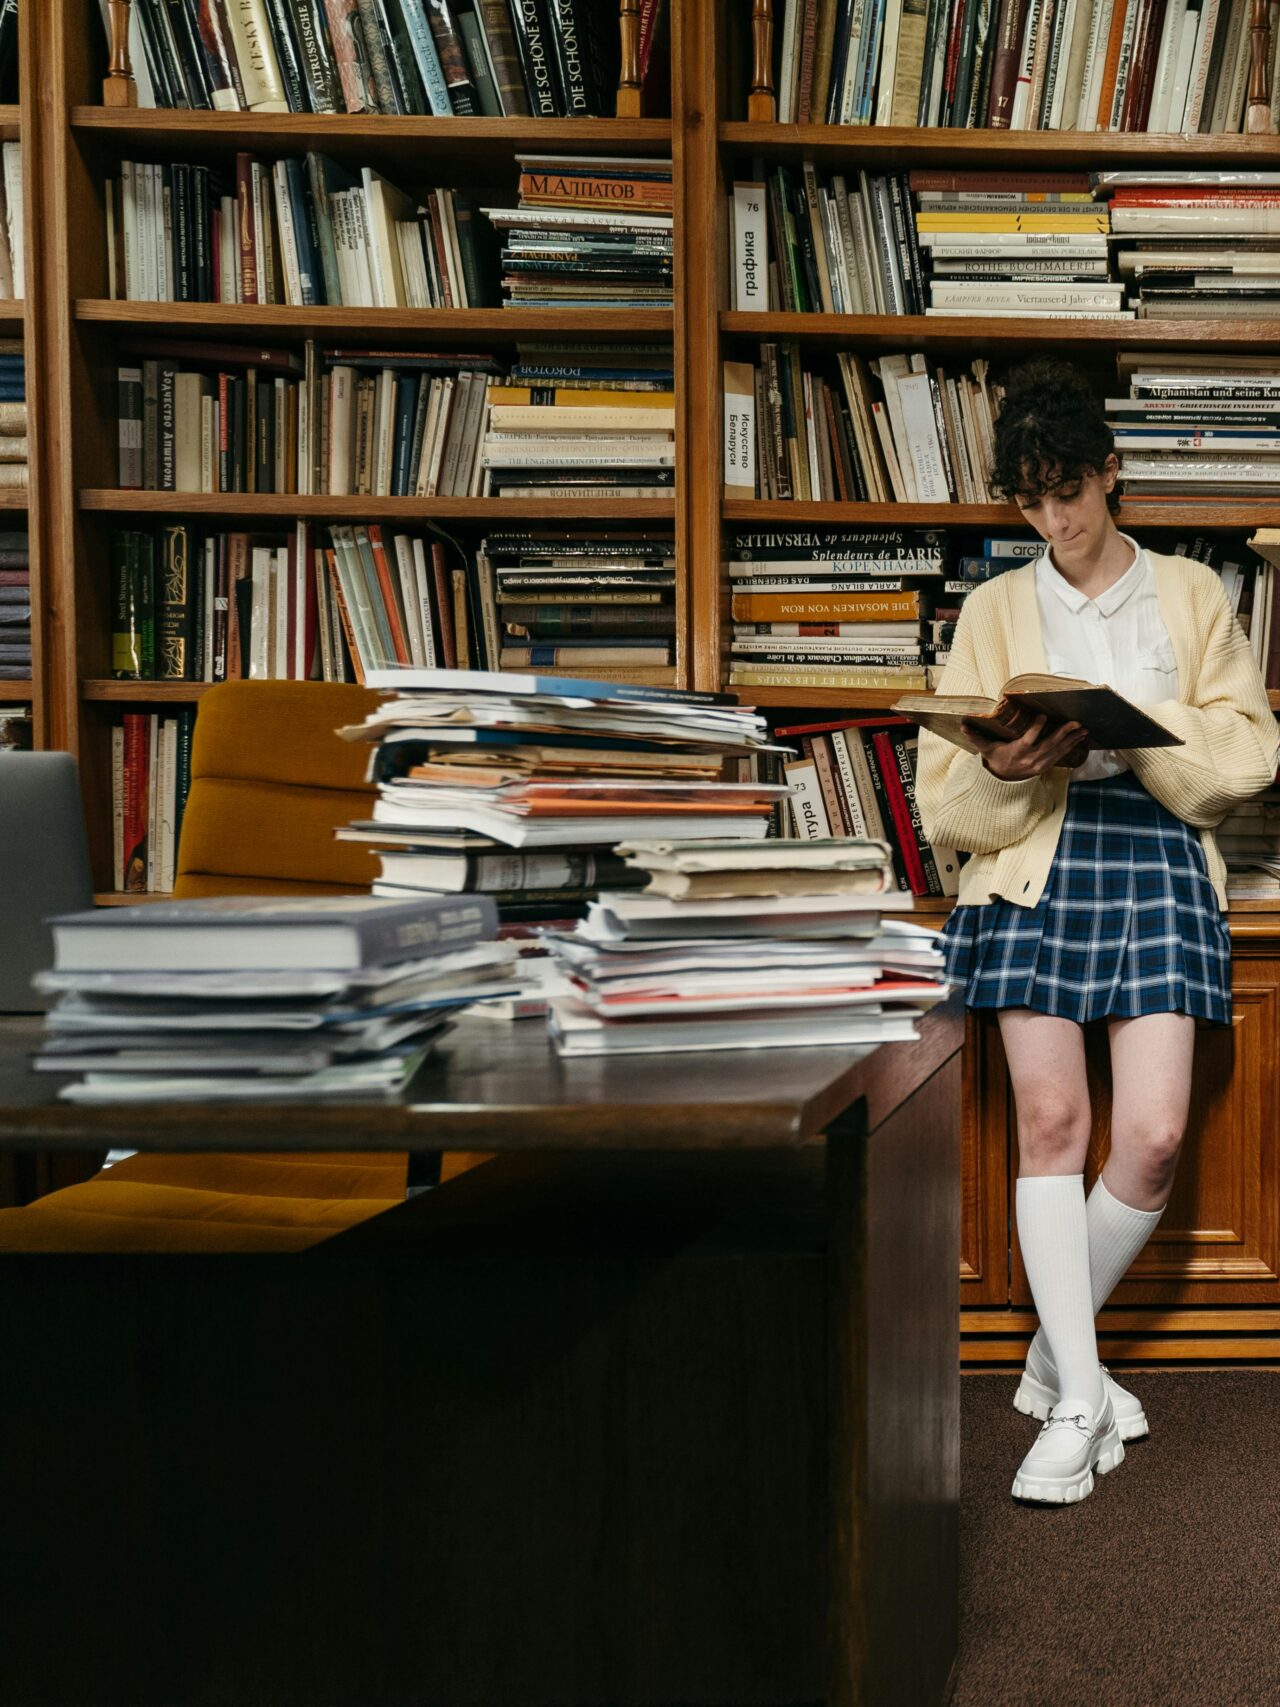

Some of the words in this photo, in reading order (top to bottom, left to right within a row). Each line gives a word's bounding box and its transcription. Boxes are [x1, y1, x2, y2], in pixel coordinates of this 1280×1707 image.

[241, 19, 265, 71] ČESKÝ
[298, 5, 325, 91] ALTRUSSISCHE
[559, 19, 582, 81] SCHÖNE
[525, 26, 549, 87] SCHÖNE
[1119, 56, 1128, 74] Platz
[1195, 68, 1207, 91] UND
[537, 90, 554, 113] DIE
[568, 84, 586, 108] DIE
[997, 95, 1009, 108] 17
[1111, 88, 1124, 127] Studenten
[1190, 94, 1202, 127] ORDEN
[530, 176, 634, 199] М.АЛПАТОВ
[746, 202, 759, 212] 76
[958, 204, 1017, 212] DEMOKRATISCHEN
[742, 231, 758, 297] графика
[1017, 294, 1067, 304] Viertausend
[1149, 386, 1209, 399] Afghanistan
[1212, 387, 1233, 398] und
[1234, 387, 1257, 398] seine
[728, 414, 738, 466] Беларуси
[741, 413, 750, 469] Искусство
[549, 489, 621, 497] ВЕНЕЦИАНОВ
[736, 533, 821, 548] VERSAILLES
[825, 534, 837, 542] de
[841, 532, 904, 544] Splendeurs
[811, 549, 874, 561] Splendeurs
[877, 550, 890, 560] de
[896, 547, 942, 561] PARIS
[831, 561, 935, 572] KOPENHAGEN
[118, 565, 127, 601] Structures
[736, 577, 789, 585] GEGENBILD
[791, 577, 810, 585] DAS
[831, 583, 865, 591] BILANG
[868, 582, 897, 591] KARLA
[119, 602, 127, 620] Steel
[780, 604, 805, 613] ROM
[808, 604, 830, 613] VON
[833, 602, 889, 612] MOSAIKEN
[890, 602, 910, 611] DIE
[422, 597, 431, 632] ИСКУССТВЕ
[766, 654, 786, 662] Loire
[787, 654, 795, 662] la
[796, 654, 806, 663] de
[807, 654, 842, 664] Châteaux
[843, 654, 884, 664] Merveilleux
[795, 676, 817, 686] LES
[822, 677, 836, 686] ET
[872, 677, 888, 687] LA
[834, 734, 855, 799] PLAKATKUNST
[865, 749, 882, 790] ILE-DE-FRANCE
[895, 744, 913, 783] France
[794, 782, 807, 791] 73
[903, 784, 916, 799] de
[909, 798, 922, 828] Rois
